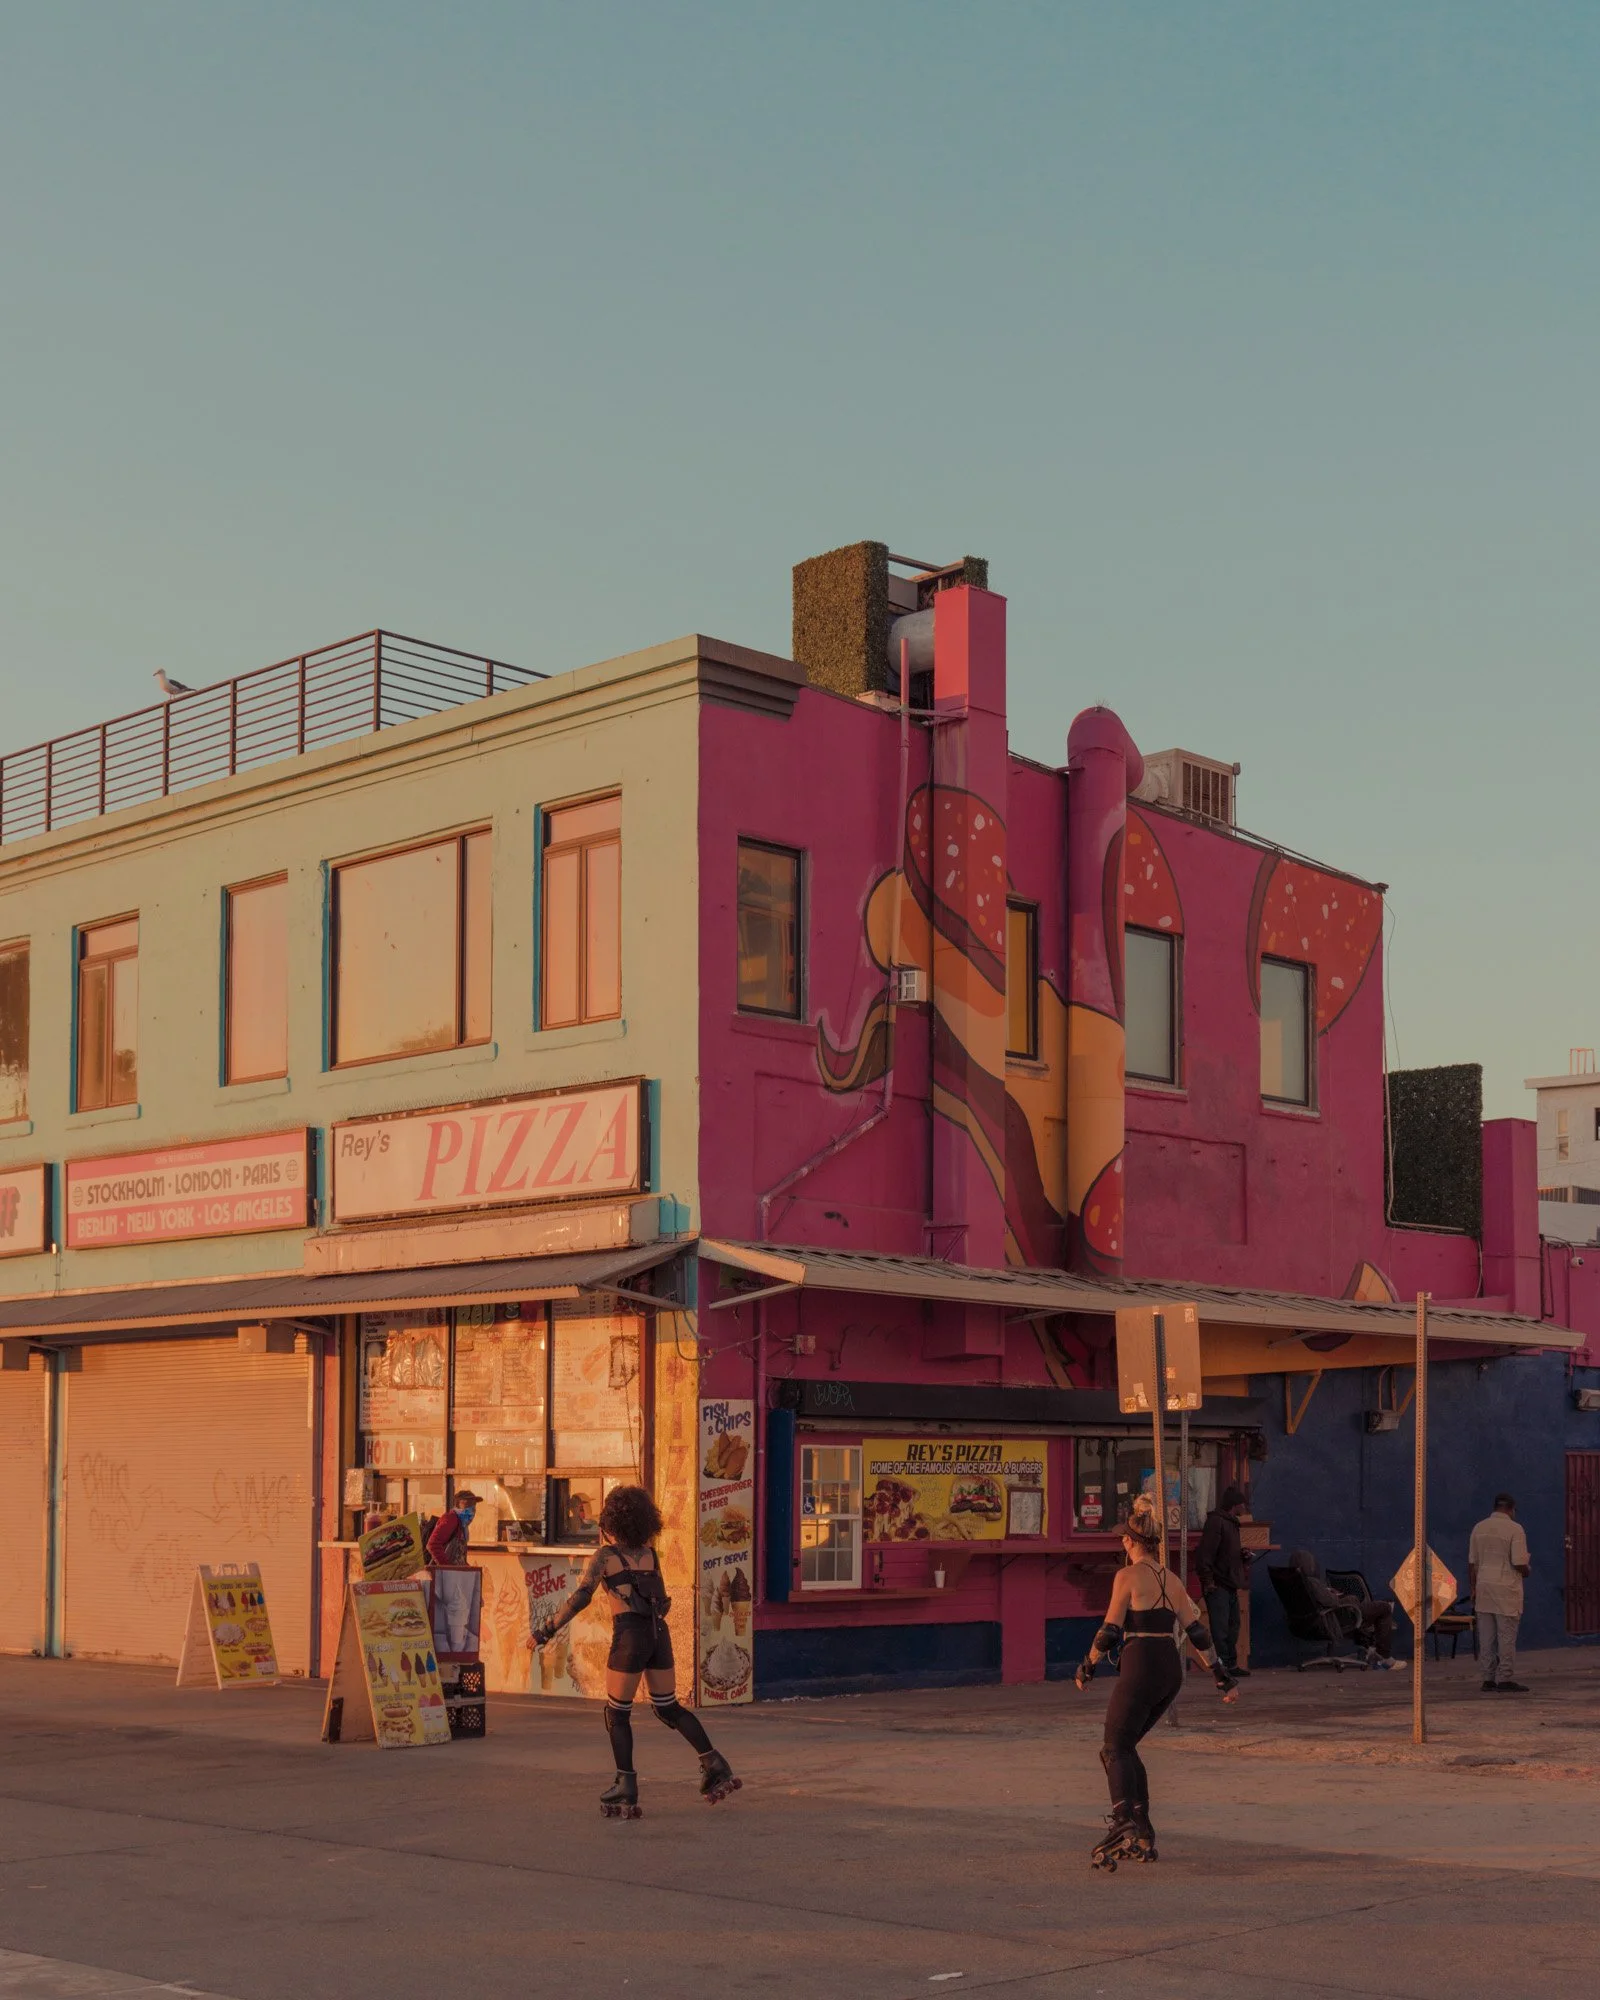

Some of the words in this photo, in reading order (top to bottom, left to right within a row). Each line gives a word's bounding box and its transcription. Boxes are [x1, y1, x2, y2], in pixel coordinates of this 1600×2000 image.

[340, 1130, 391, 1161] Rey's
[414, 1092, 632, 1201] PIZZA
[87, 1175, 165, 1205] STOCKHOLM
[175, 1167, 232, 1195] LONDON
[243, 1160, 280, 1187] PARIS
[77, 1213, 118, 1239] BERLIN
[127, 1210, 156, 1234] NEW
[159, 1205, 195, 1231] YORK
[204, 1199, 231, 1226] LOS
[234, 1195, 293, 1224] ANGELES
[703, 1401, 729, 1421] FISH
[708, 1426, 714, 1436] &
[715, 1411, 751, 1435] CHIPS
[366, 1439, 390, 1465] HOT
[907, 1444, 953, 1461] REY'S
[956, 1444, 1002, 1461] PIZZA
[870, 1461, 893, 1475] HOME
[894, 1461, 905, 1475] OF
[906, 1461, 921, 1475] THE
[921, 1461, 951, 1475] FAMOUS
[953, 1461, 979, 1475] VENICE
[980, 1461, 1001, 1475] PIZZA
[1004, 1461, 1010, 1475] &
[1011, 1461, 1043, 1475] BURGERS
[700, 1478, 753, 1501] CHEESEBURGER
[702, 1502, 707, 1512] &
[709, 1496, 729, 1510] FRIES
[703, 1557, 722, 1571] SOFT
[724, 1550, 749, 1565] SERVE
[525, 1563, 552, 1586] SOFT
[532, 1573, 566, 1599] SERVE
[704, 1687, 729, 1701] FUNNEL
[731, 1683, 748, 1700] CAKE
